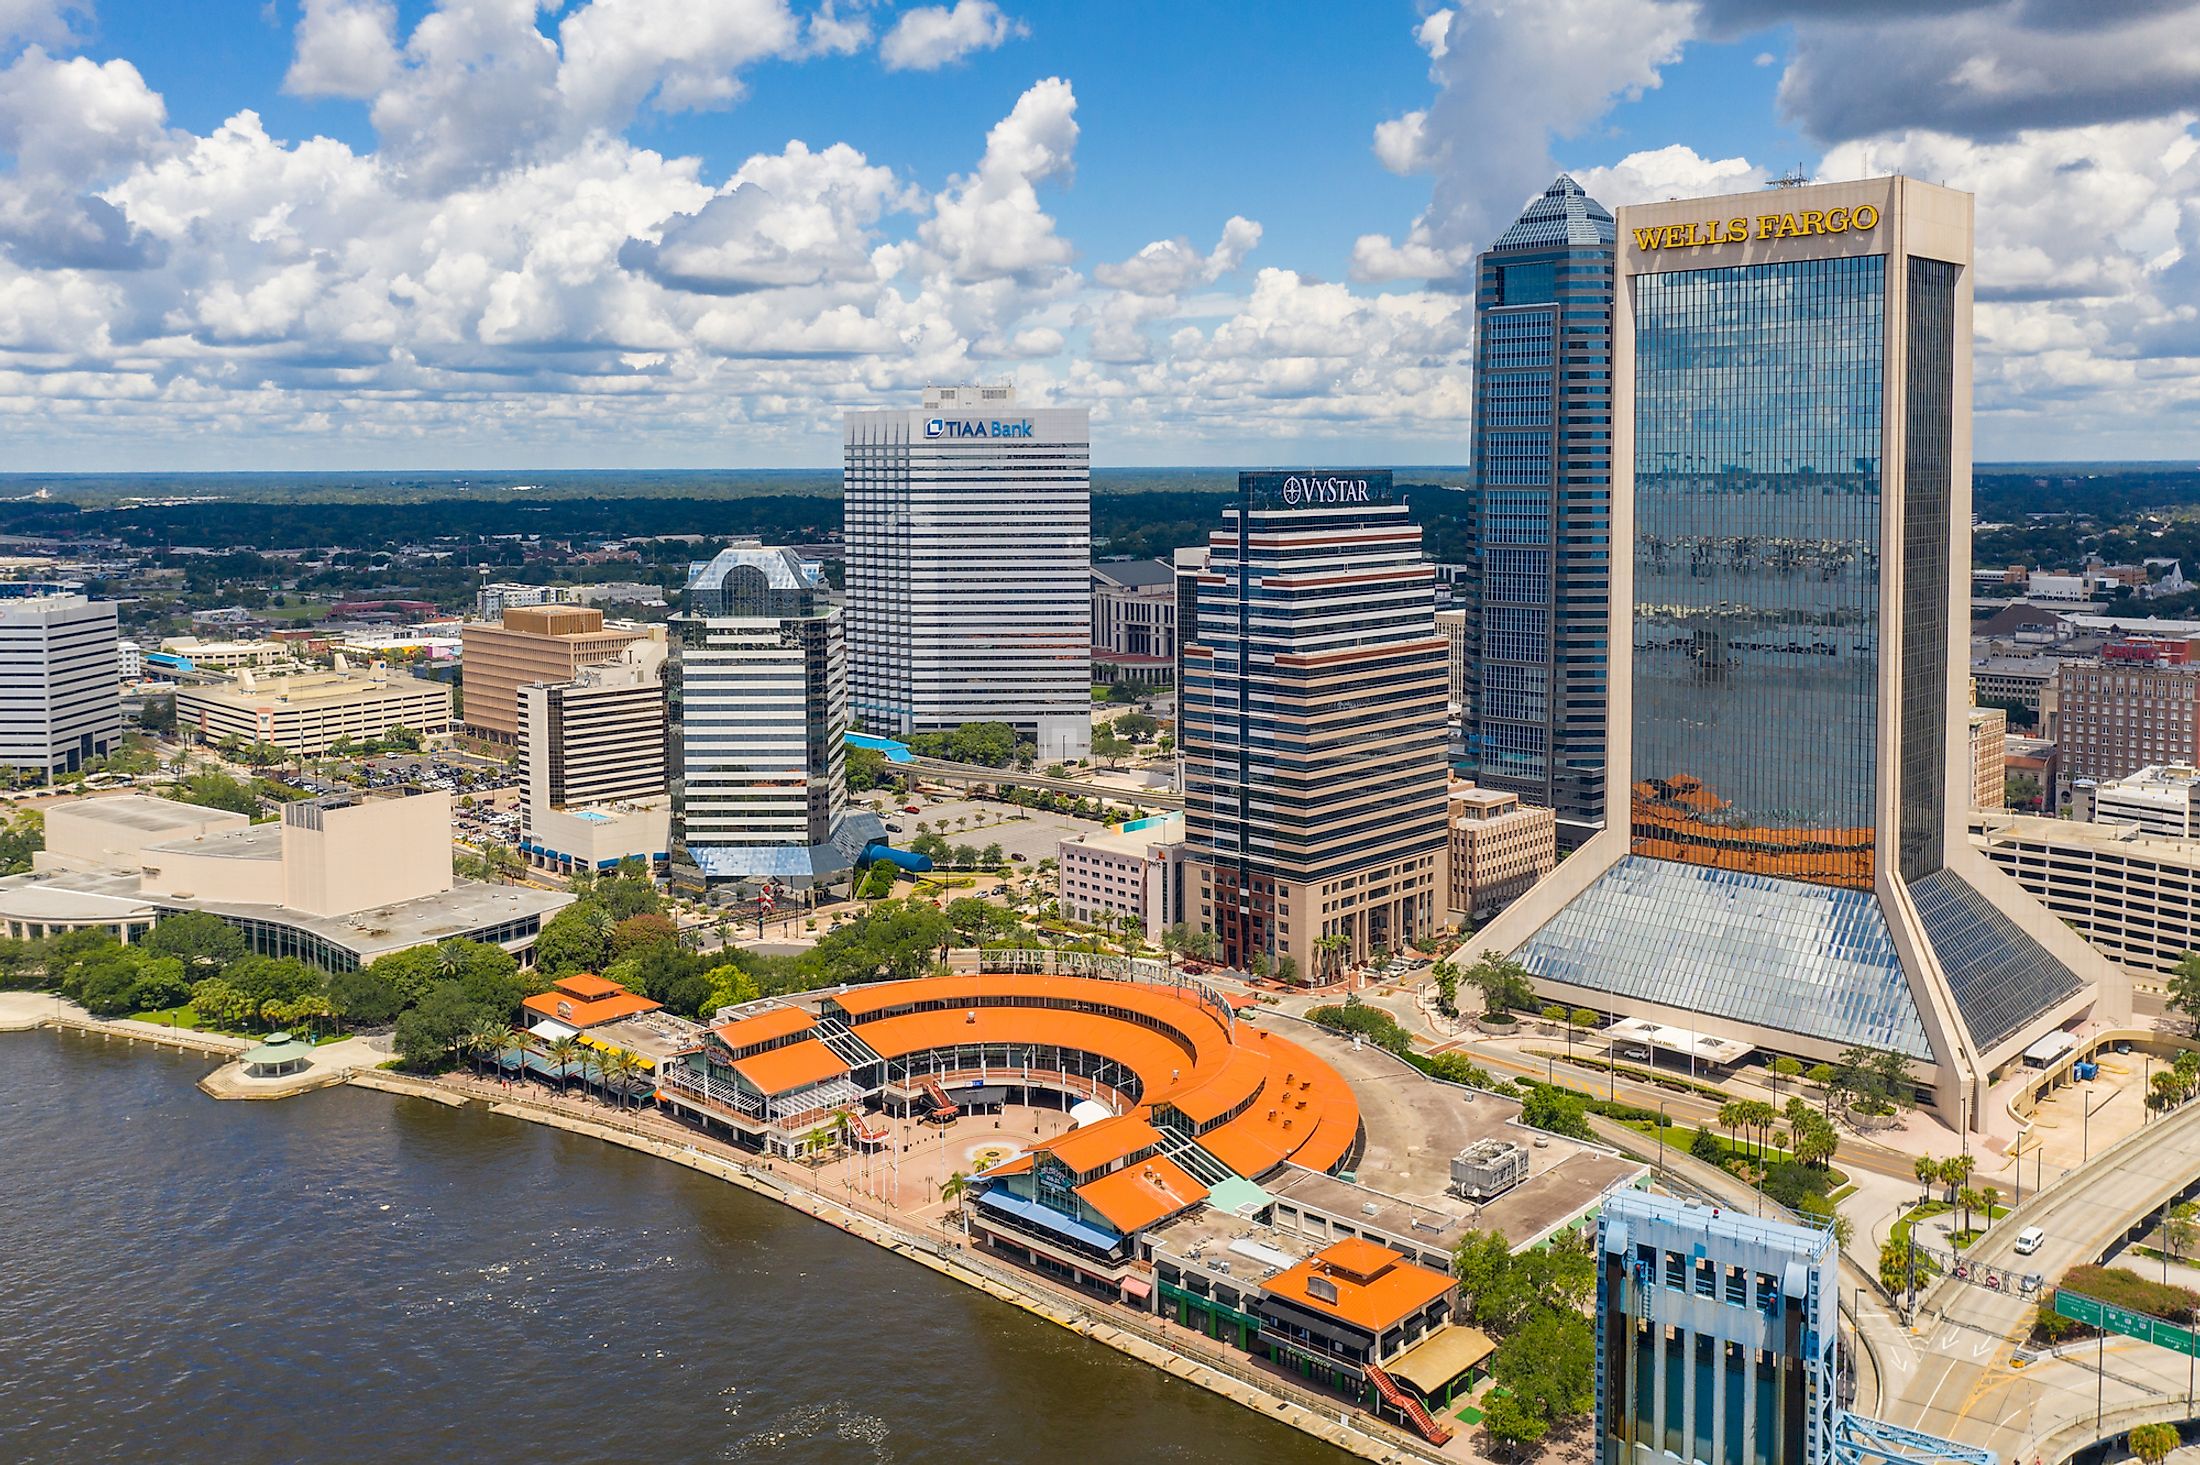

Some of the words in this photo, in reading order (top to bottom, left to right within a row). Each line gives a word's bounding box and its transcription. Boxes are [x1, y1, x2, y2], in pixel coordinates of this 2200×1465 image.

[1633, 217, 1748, 251] WELLS
[1756, 205, 1879, 240] FARGO
[945, 420, 987, 438] TIAA
[991, 419, 1032, 438] Bank
